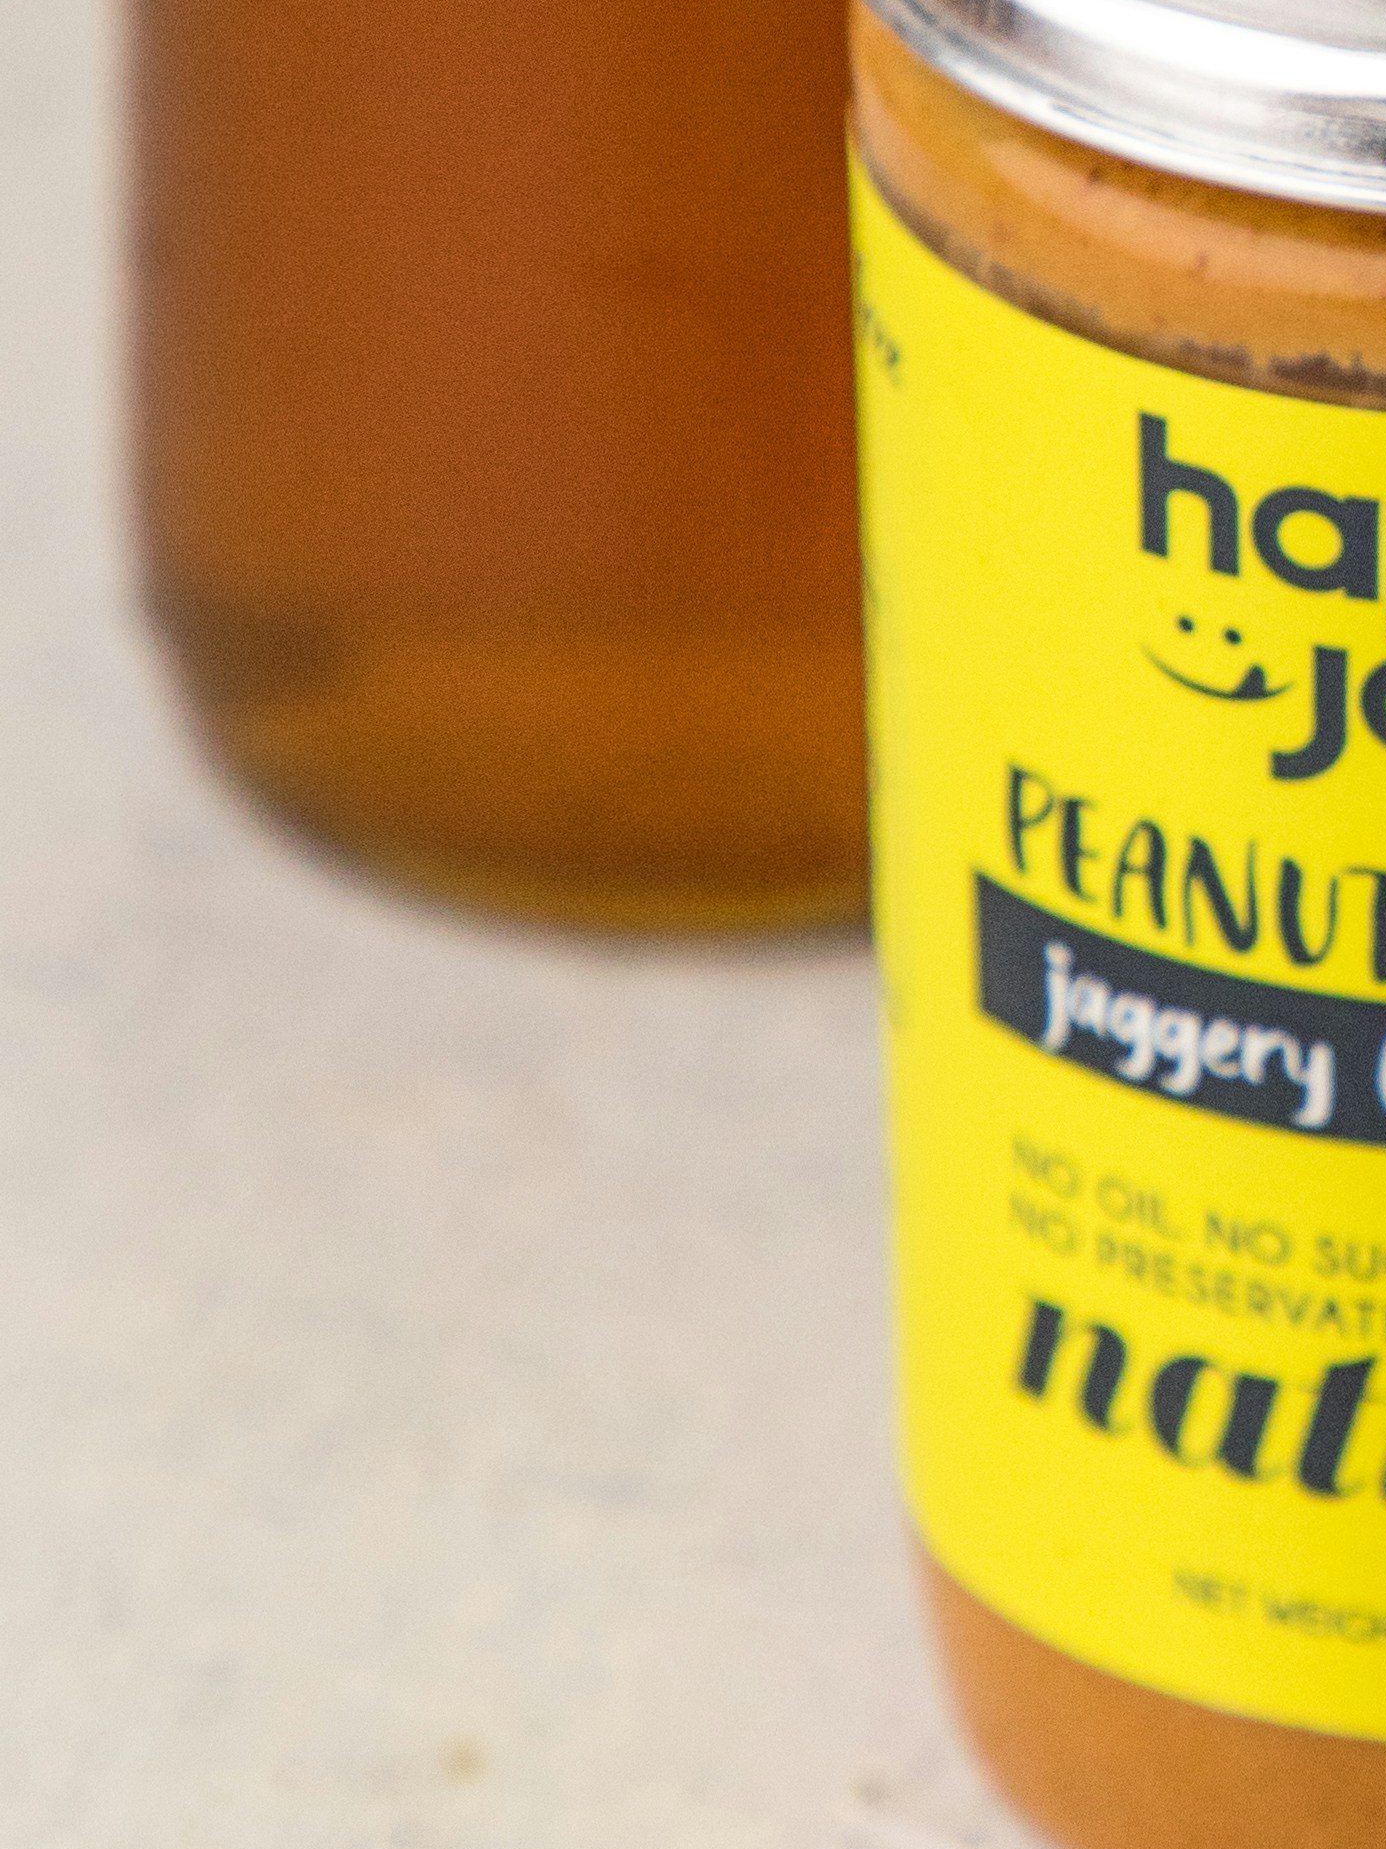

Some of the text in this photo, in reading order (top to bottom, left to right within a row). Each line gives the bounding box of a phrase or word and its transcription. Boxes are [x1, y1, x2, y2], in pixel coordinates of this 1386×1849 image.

[1041, 941, 1336, 1130] jaggery
[1009, 1190, 1080, 1255] NO
[1011, 1133, 1081, 1200] NO
[1204, 1208, 1294, 1266] NO
